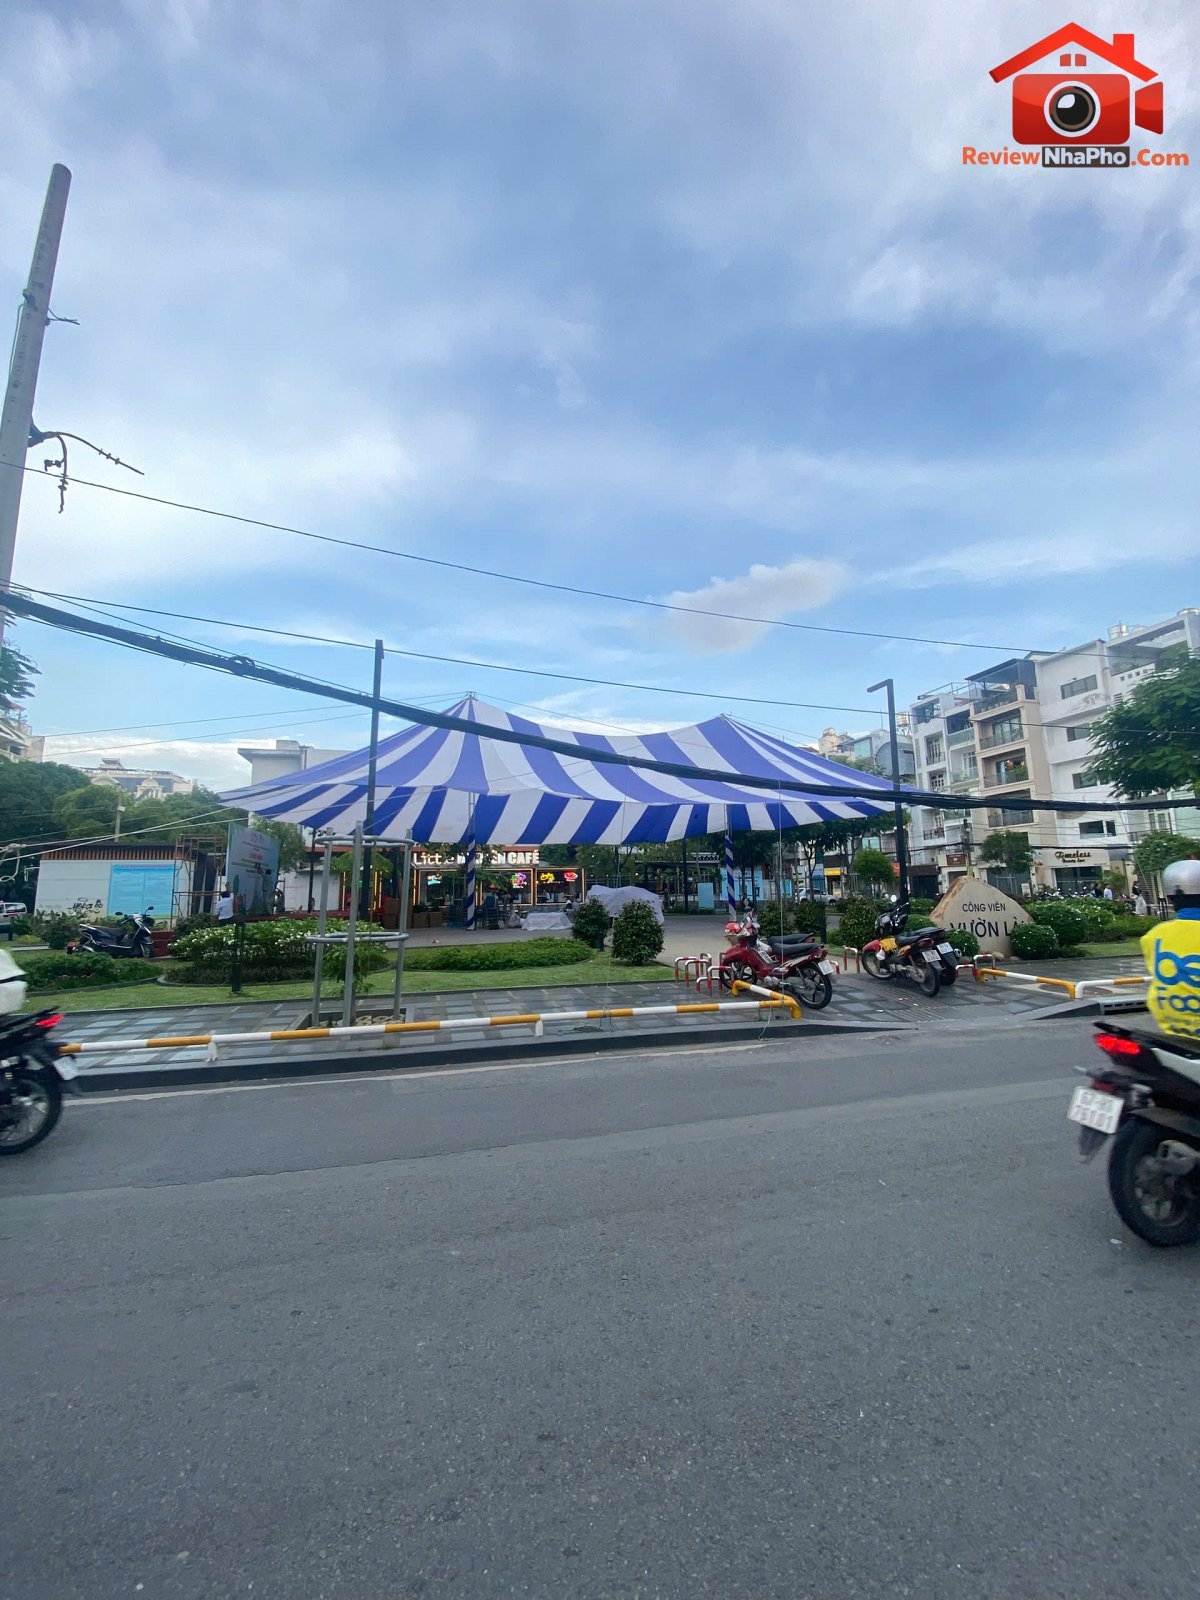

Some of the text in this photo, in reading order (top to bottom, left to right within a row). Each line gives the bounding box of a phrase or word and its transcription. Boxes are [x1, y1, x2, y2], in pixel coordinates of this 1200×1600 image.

[413, 852, 455, 865] Litte
[507, 849, 540, 864] CAFÉ
[1055, 850, 1092, 859] Timeless
[962, 901, 1006, 912] CÔNG VIÊN
